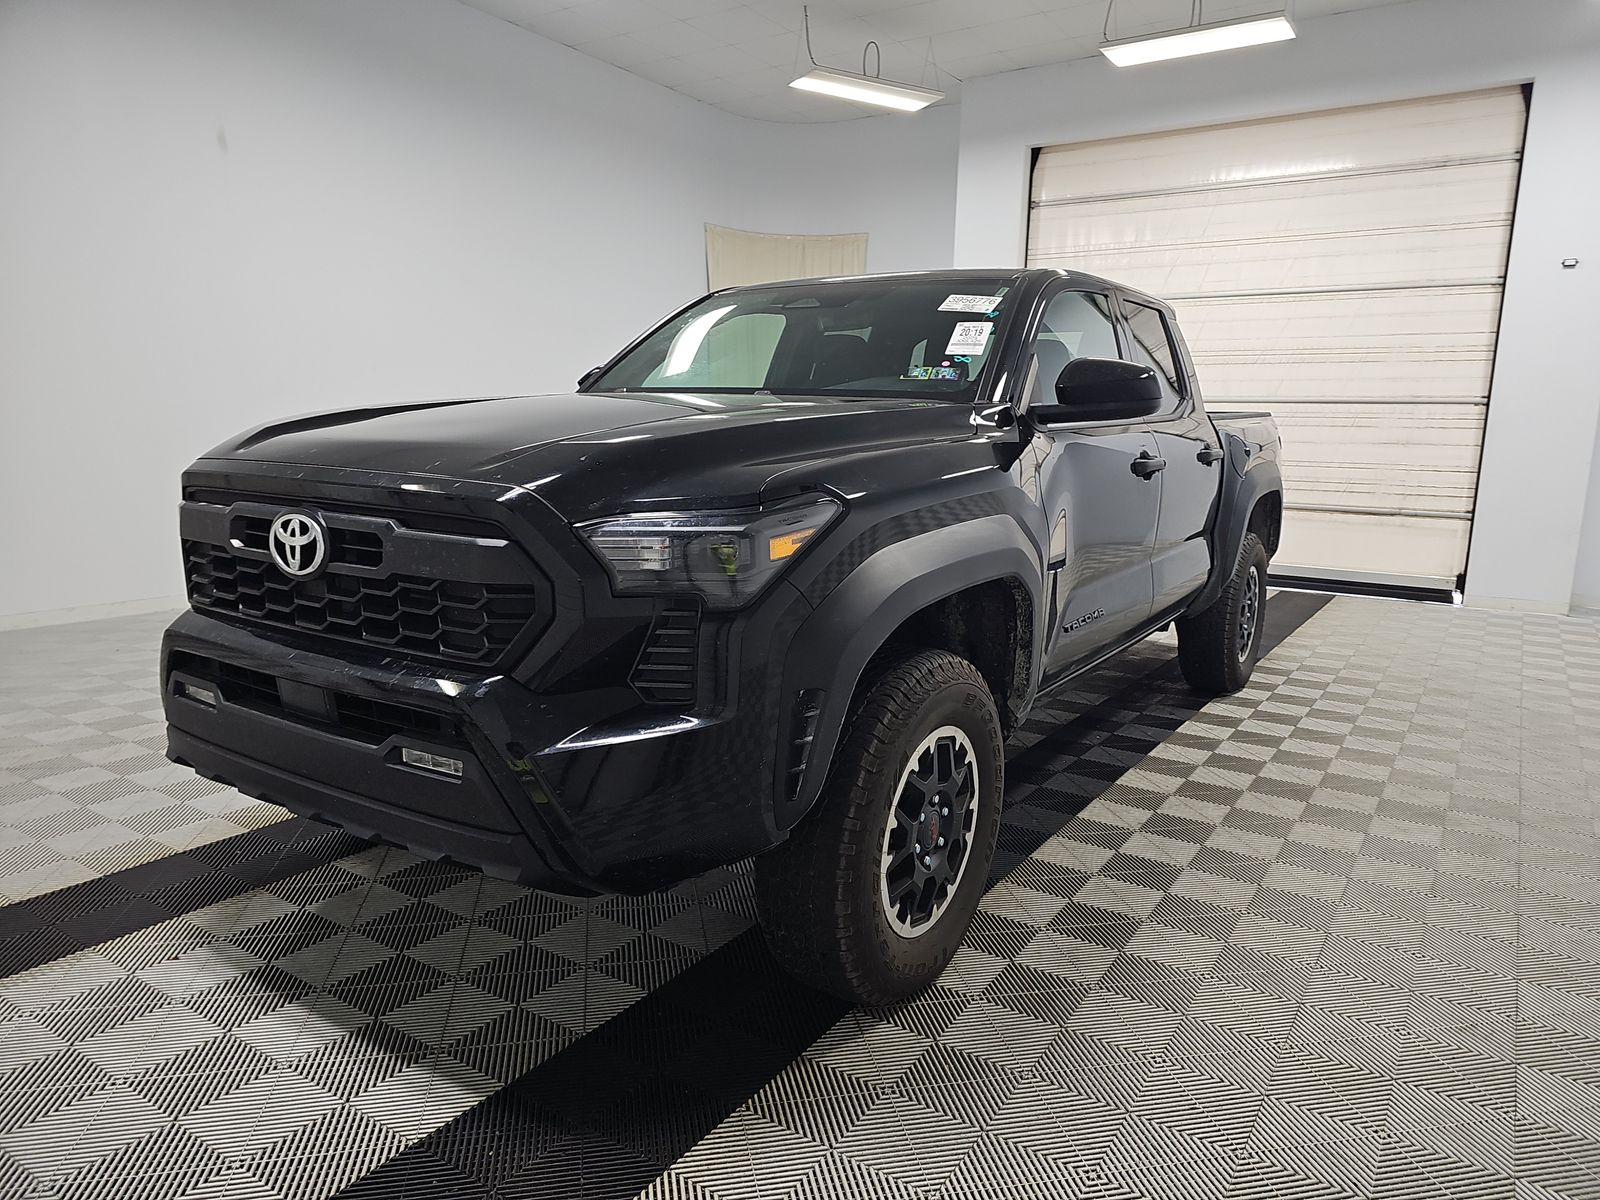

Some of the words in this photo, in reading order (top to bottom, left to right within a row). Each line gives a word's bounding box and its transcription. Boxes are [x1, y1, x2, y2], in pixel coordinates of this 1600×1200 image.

[948, 296, 998, 305] 3956776
[959, 328, 984, 337] 20:19
[1062, 607, 1105, 634] TACOMA
